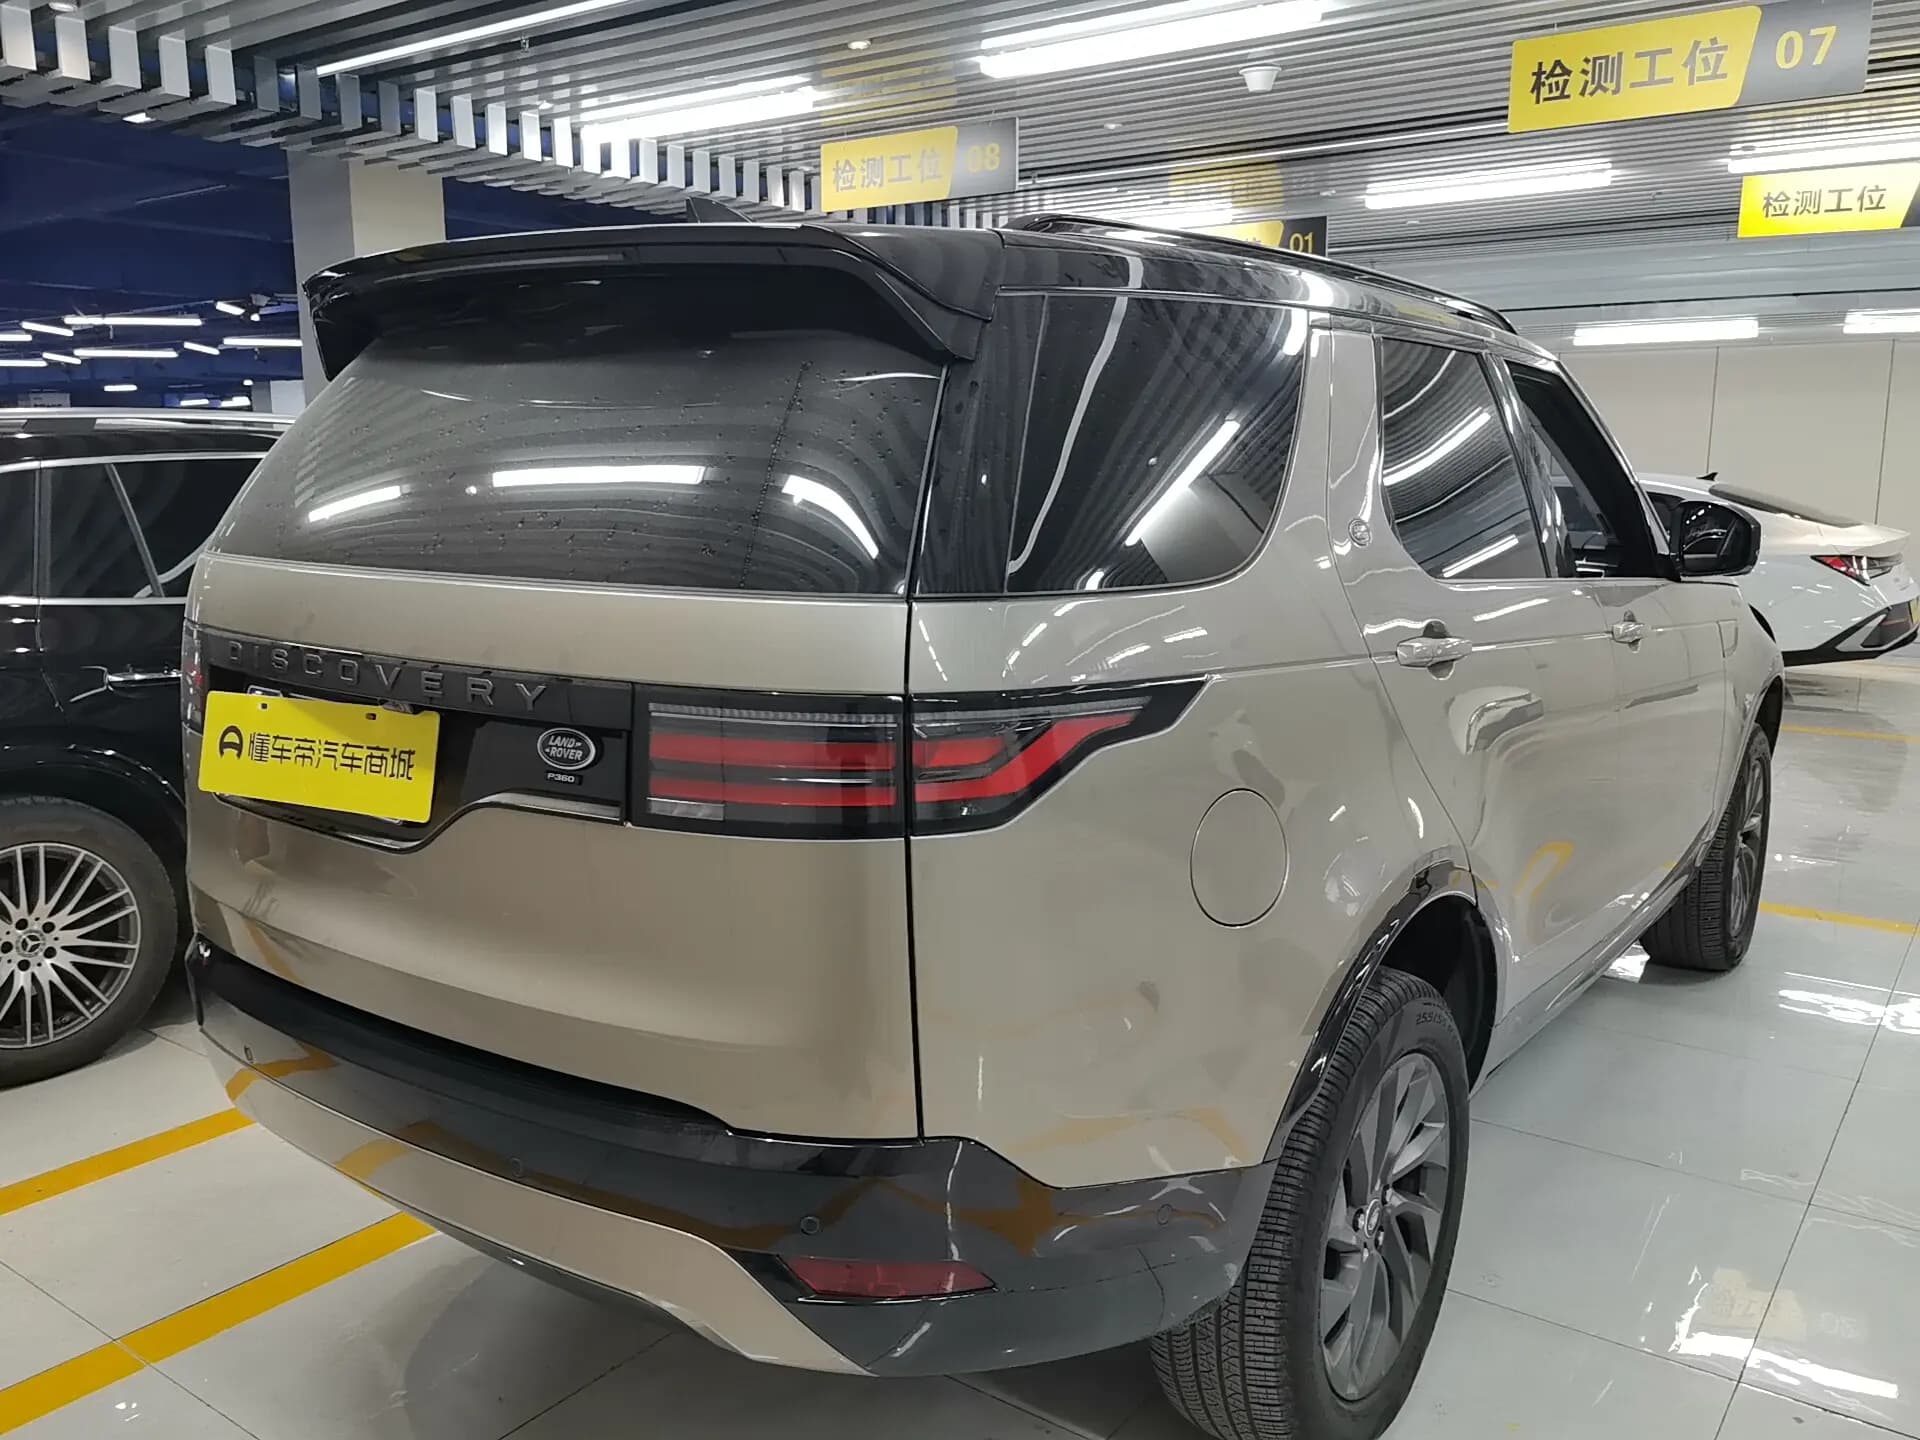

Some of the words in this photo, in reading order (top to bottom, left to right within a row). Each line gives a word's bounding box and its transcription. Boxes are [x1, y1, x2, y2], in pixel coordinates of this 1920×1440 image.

[1530, 36, 1730, 106] 检测工位
[1775, 25, 1838, 70] 07
[832, 145, 942, 193] 检测工位
[967, 142, 1001, 173] 08
[1762, 184, 1888, 219] 检测工位
[1289, 231, 1315, 254] 01
[228, 640, 548, 712] DISCOVERY
[247, 731, 415, 782] 懂车帝汽车商城
[548, 735, 576, 748] LAND
[549, 746, 584, 761] ROVER
[546, 772, 575, 783] P360
